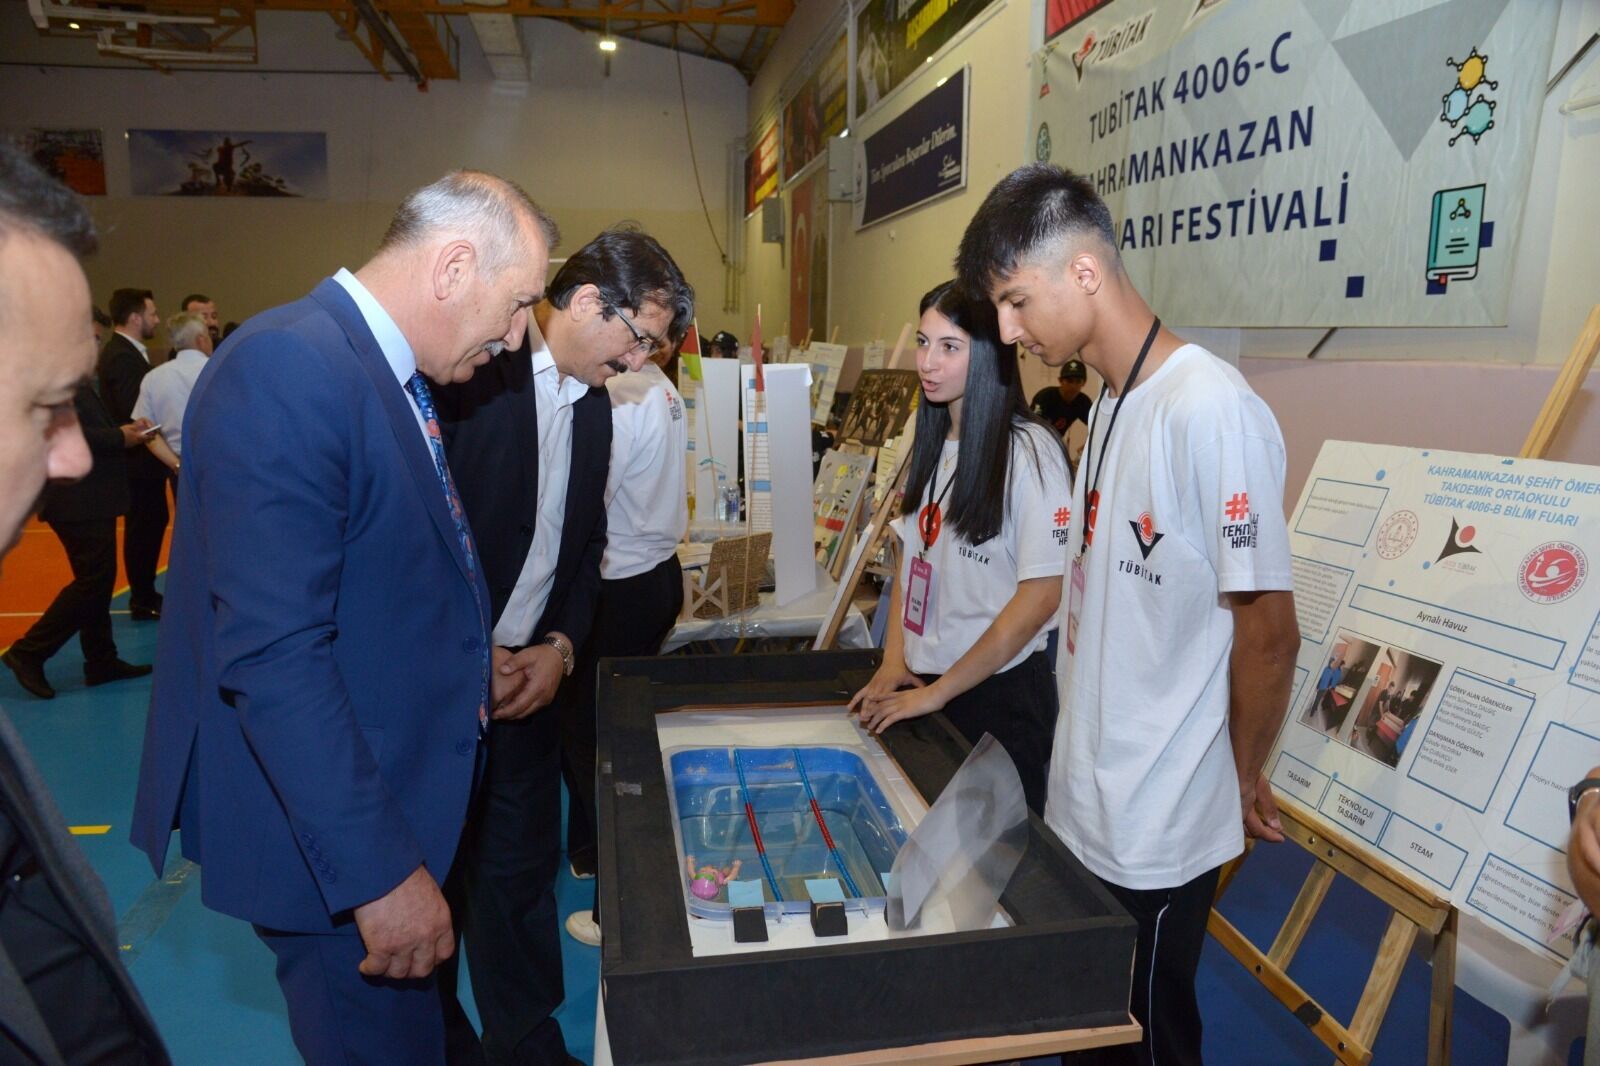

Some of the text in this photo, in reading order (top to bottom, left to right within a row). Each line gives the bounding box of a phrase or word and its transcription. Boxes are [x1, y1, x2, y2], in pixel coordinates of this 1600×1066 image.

[1092, 14, 1152, 64] TÜBİTAK
[1173, 31, 1292, 104] 4006-C
[1090, 106, 1314, 196] HRAMANKAZAN
[1171, 171, 1349, 245] FESTİVALİ
[1428, 465, 1524, 486] KAHRAMANKAZAN
[1525, 475, 1563, 490] ŞEHİT
[1441, 481, 1571, 508] TAKDEMİR ORTAOKULU
[1423, 493, 1579, 527] TÜBİTAK 4006-B BİLİM FUARI
[958, 547, 990, 566] TÜBİTAK
[1119, 560, 1163, 586] TÜBİTAK
[1416, 611, 1468, 632] Aynalı Havuz
[1287, 770, 1312, 789] TASARIM
[1337, 806, 1365, 828] TASARIM
[1338, 793, 1375, 820] TEKNOLOJİ
[1409, 841, 1434, 860] STEAM
